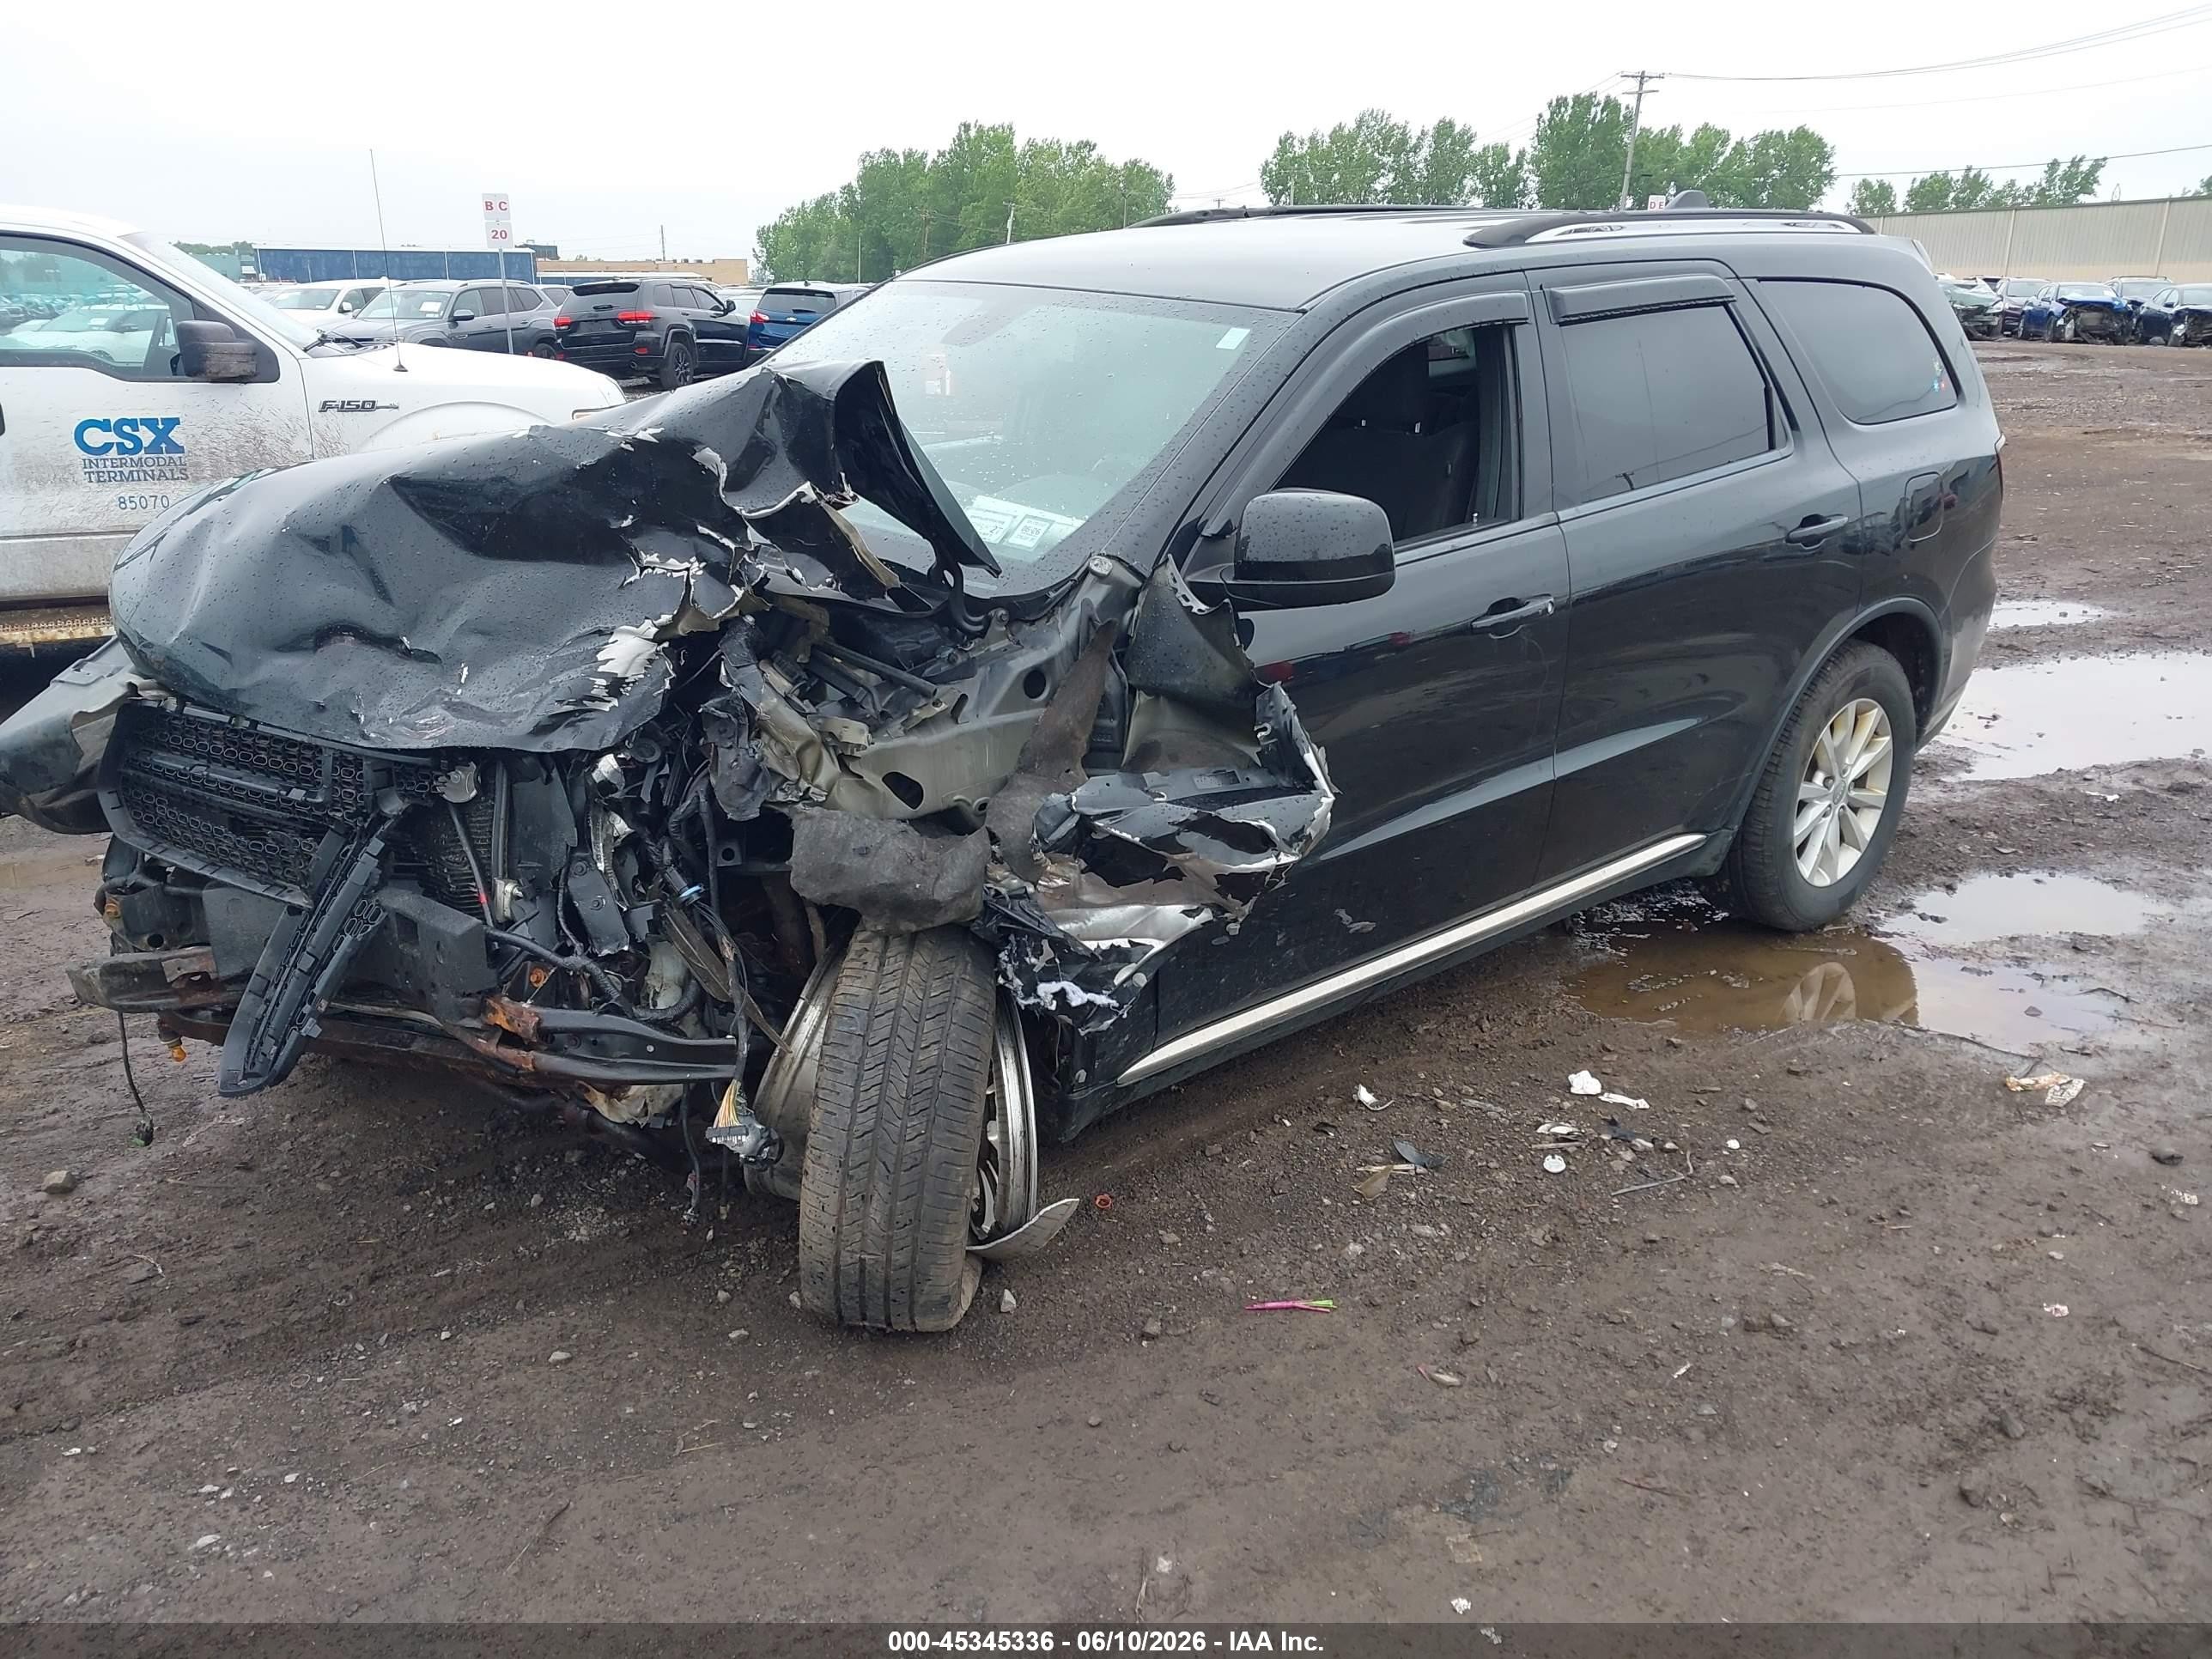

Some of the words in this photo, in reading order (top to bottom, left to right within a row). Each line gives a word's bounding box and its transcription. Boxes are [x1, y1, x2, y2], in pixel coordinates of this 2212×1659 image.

[484, 200, 494, 211] B
[498, 201, 508, 211] C
[1650, 201, 1656, 210] D
[1658, 201, 1665, 210] E
[491, 229, 507, 240] 20
[318, 400, 378, 413] F-150
[74, 416, 185, 456] CSX
[82, 455, 188, 470] INTERMODAL
[83, 468, 190, 483] TERMINALS
[118, 495, 170, 510] 85070
